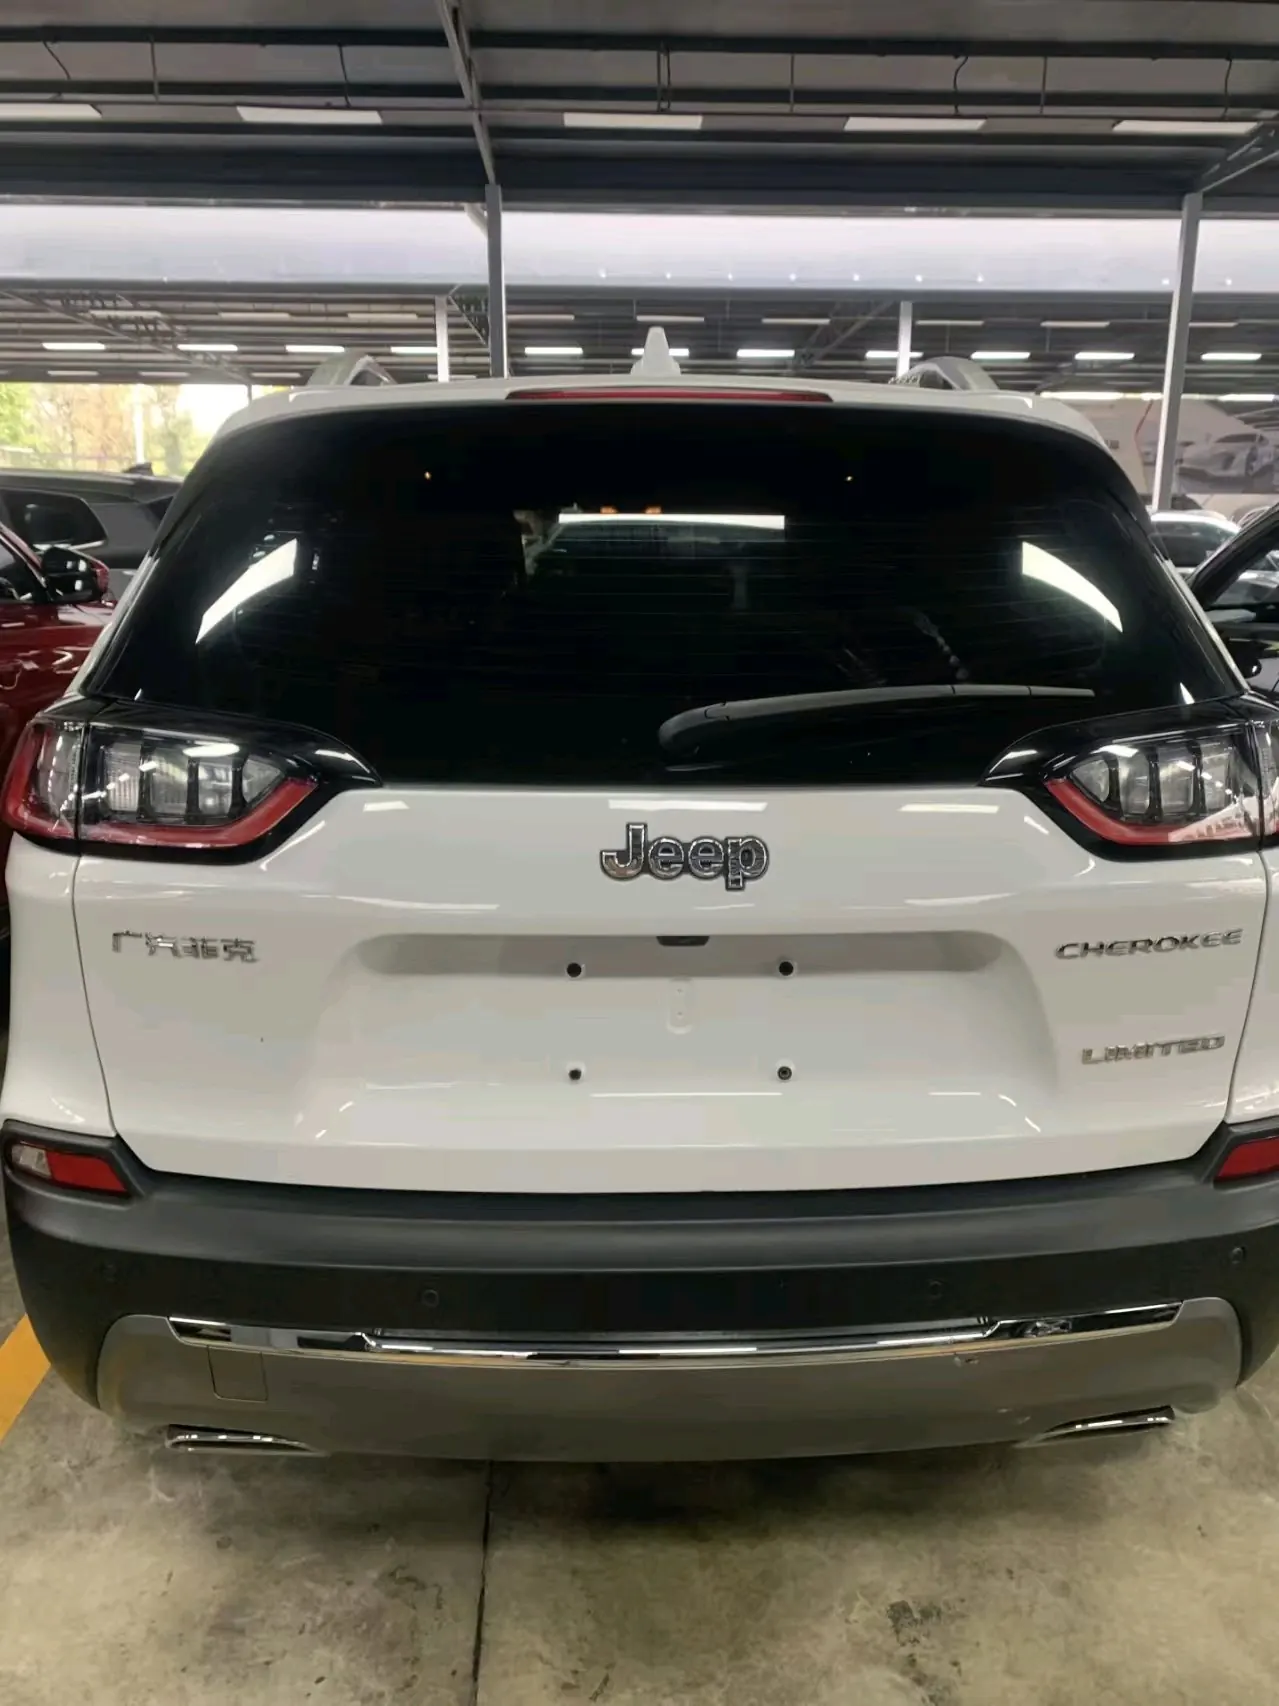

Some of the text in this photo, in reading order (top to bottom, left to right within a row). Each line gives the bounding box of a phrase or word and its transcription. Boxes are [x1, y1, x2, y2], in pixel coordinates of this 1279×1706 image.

[600, 822, 770, 891] Jeep
[112, 930, 258, 963] 广汽菲克
[1055, 928, 1243, 959] CHEROKEE
[1082, 1034, 1225, 1064] LIMITED
